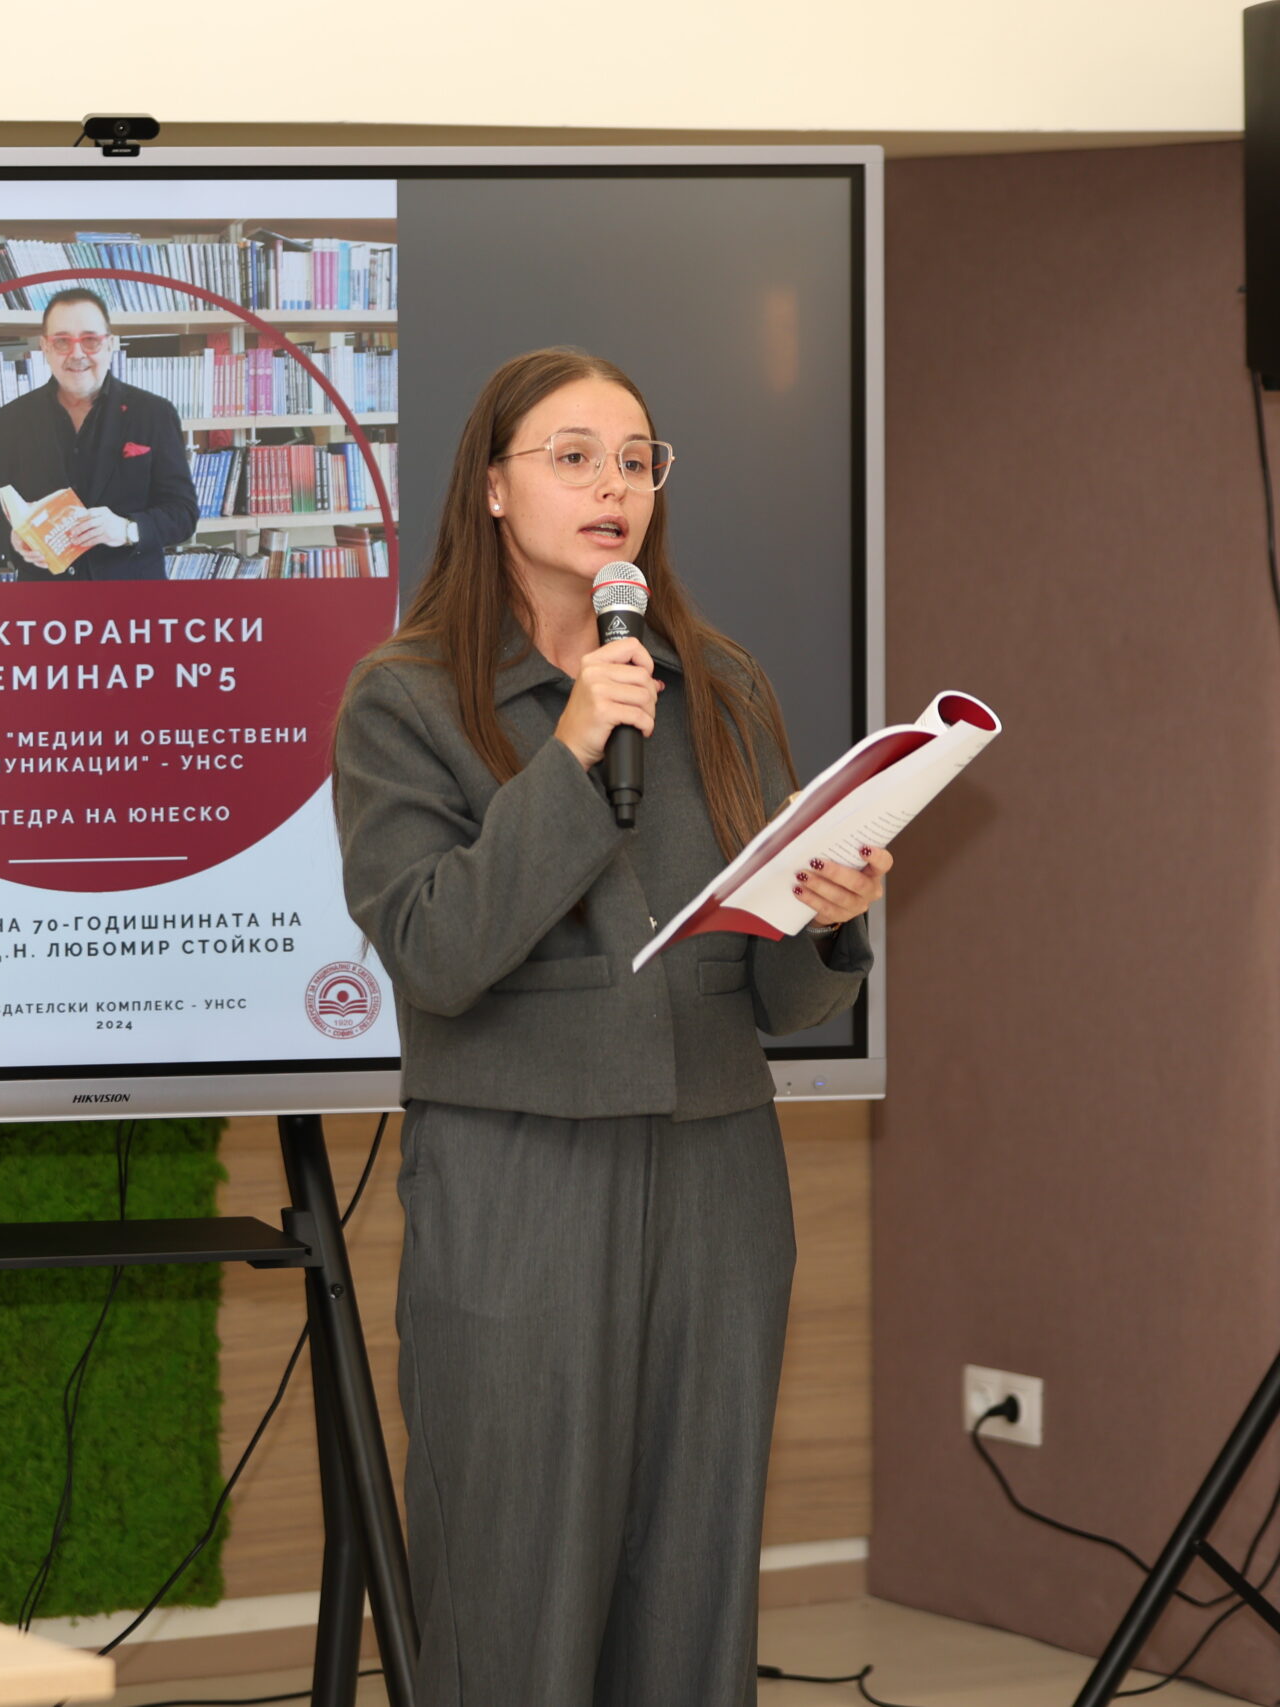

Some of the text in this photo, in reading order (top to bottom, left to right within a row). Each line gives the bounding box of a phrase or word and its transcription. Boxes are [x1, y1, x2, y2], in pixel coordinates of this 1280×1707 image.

[6, 730, 103, 751] "МЕДИИ
[115, 730, 129, 746] И
[140, 727, 307, 749] ОБЩЕСТВЕНИ
[180, 753, 244, 771] УНСС
[86, 807, 117, 824] НА
[128, 805, 230, 823] ЮНЕСКО
[32, 912, 260, 935] 70-ГОДИШНИНАТА
[271, 911, 302, 927] НА
[46, 940, 170, 958] ЛЮБОМИР
[181, 934, 295, 955] СТОЙКОВ
[96, 999, 184, 1013] КОМПЛЕКС
[204, 998, 247, 1011] УНСС
[96, 1020, 133, 1031] 2024
[72, 1093, 131, 1104] HIKVISION
